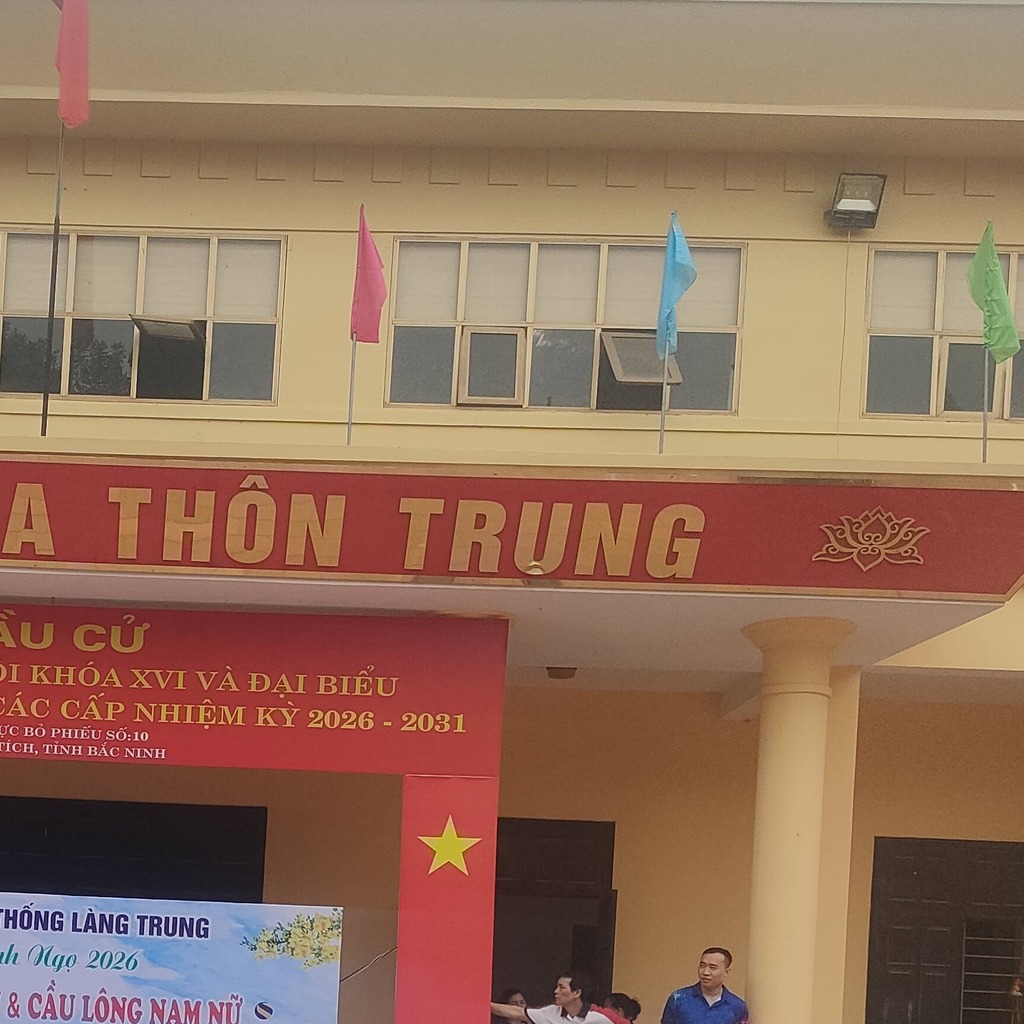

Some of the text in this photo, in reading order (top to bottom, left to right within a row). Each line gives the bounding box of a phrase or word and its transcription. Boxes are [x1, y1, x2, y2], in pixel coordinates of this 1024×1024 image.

[108, 474, 347, 567] THÔN
[398, 497, 707, 579] TRUNG
[73, 614, 151, 654] CỬ
[30, 661, 124, 688] KHÓA
[130, 668, 187, 691] XVI
[195, 665, 241, 693] VÀ
[247, 672, 307, 699] ĐẠI
[316, 664, 400, 698] BIỂU
[60, 692, 125, 721] CẤP
[133, 699, 246, 730] NHIỆM
[255, 701, 301, 728] KỲ
[307, 709, 375, 731] 2026
[400, 712, 467, 734] 2031
[23, 723, 46, 738] BỎ
[50, 725, 102, 741] PHIẾU
[106, 727, 149, 742] SỐ:10
[42, 740, 82, 756] TỈNH
[87, 742, 120, 758] BẮC
[124, 747, 167, 759] NINH
[71, 908, 129, 935] LÀNG
[137, 914, 210, 939] TRUNG
[28, 944, 78, 972] Ngọ
[85, 949, 139, 971] 2026
[7, 991, 20, 1019] &
[27, 979, 76, 1021] CẦU
[81, 987, 143, 1024] LÔNG
